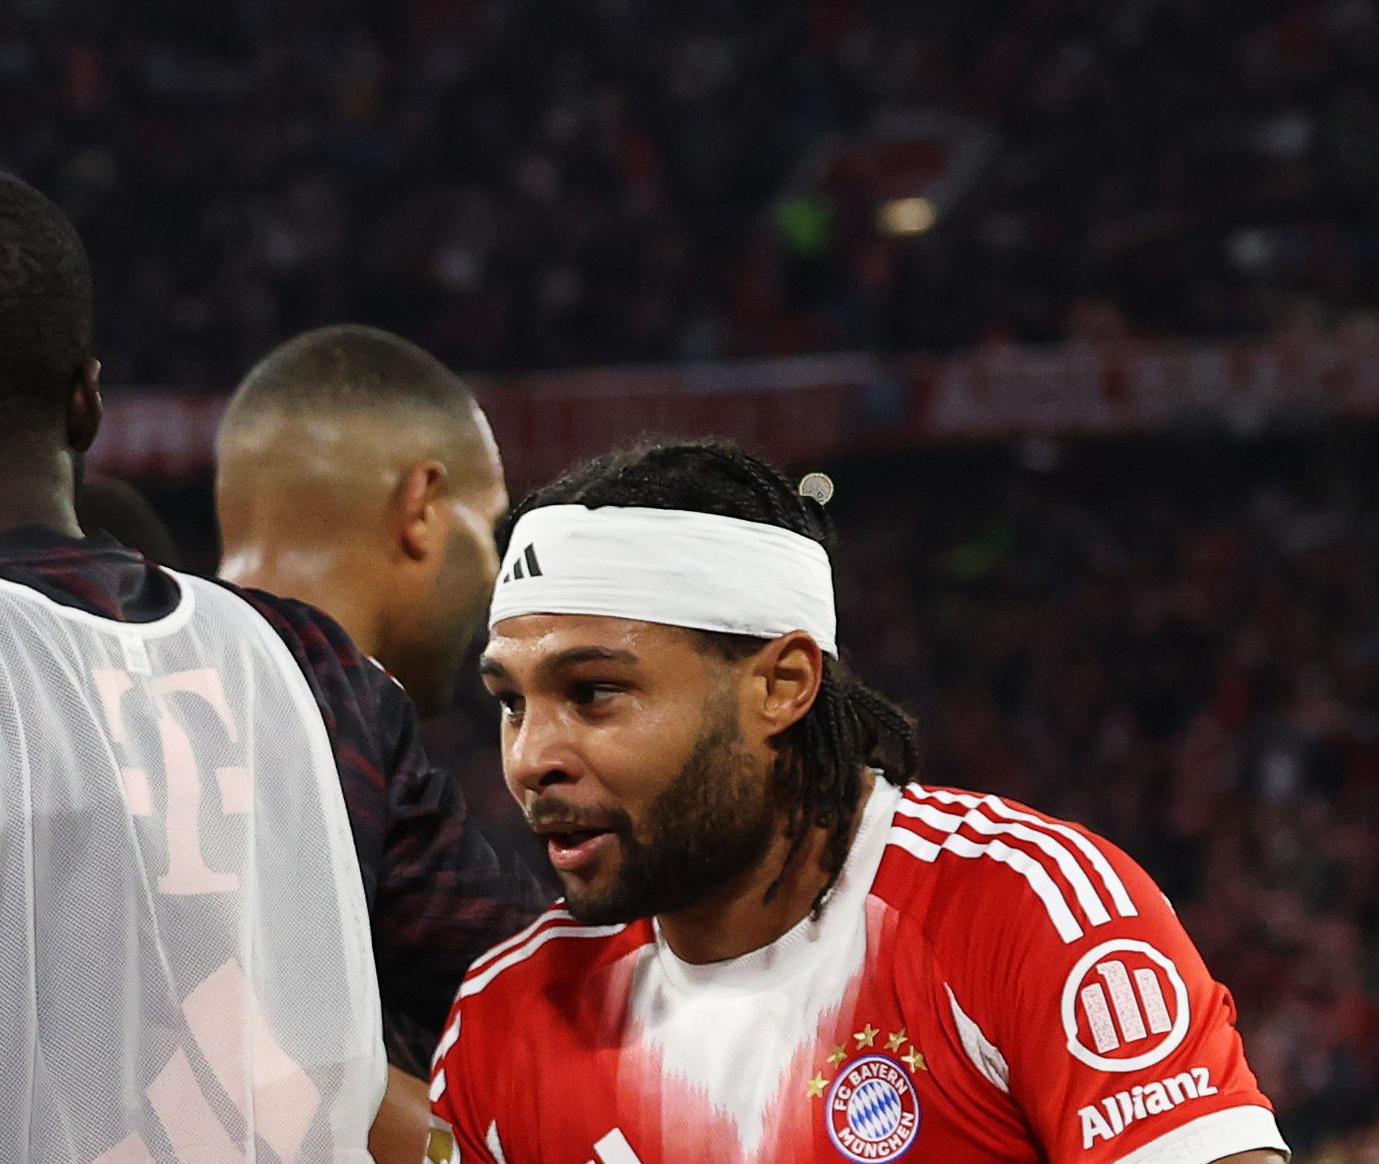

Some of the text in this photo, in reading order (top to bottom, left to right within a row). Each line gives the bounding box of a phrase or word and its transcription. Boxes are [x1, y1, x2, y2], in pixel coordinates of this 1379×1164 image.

[833, 1063, 908, 1111] FC BAYERN
[1077, 1067, 1219, 1150] Allianz
